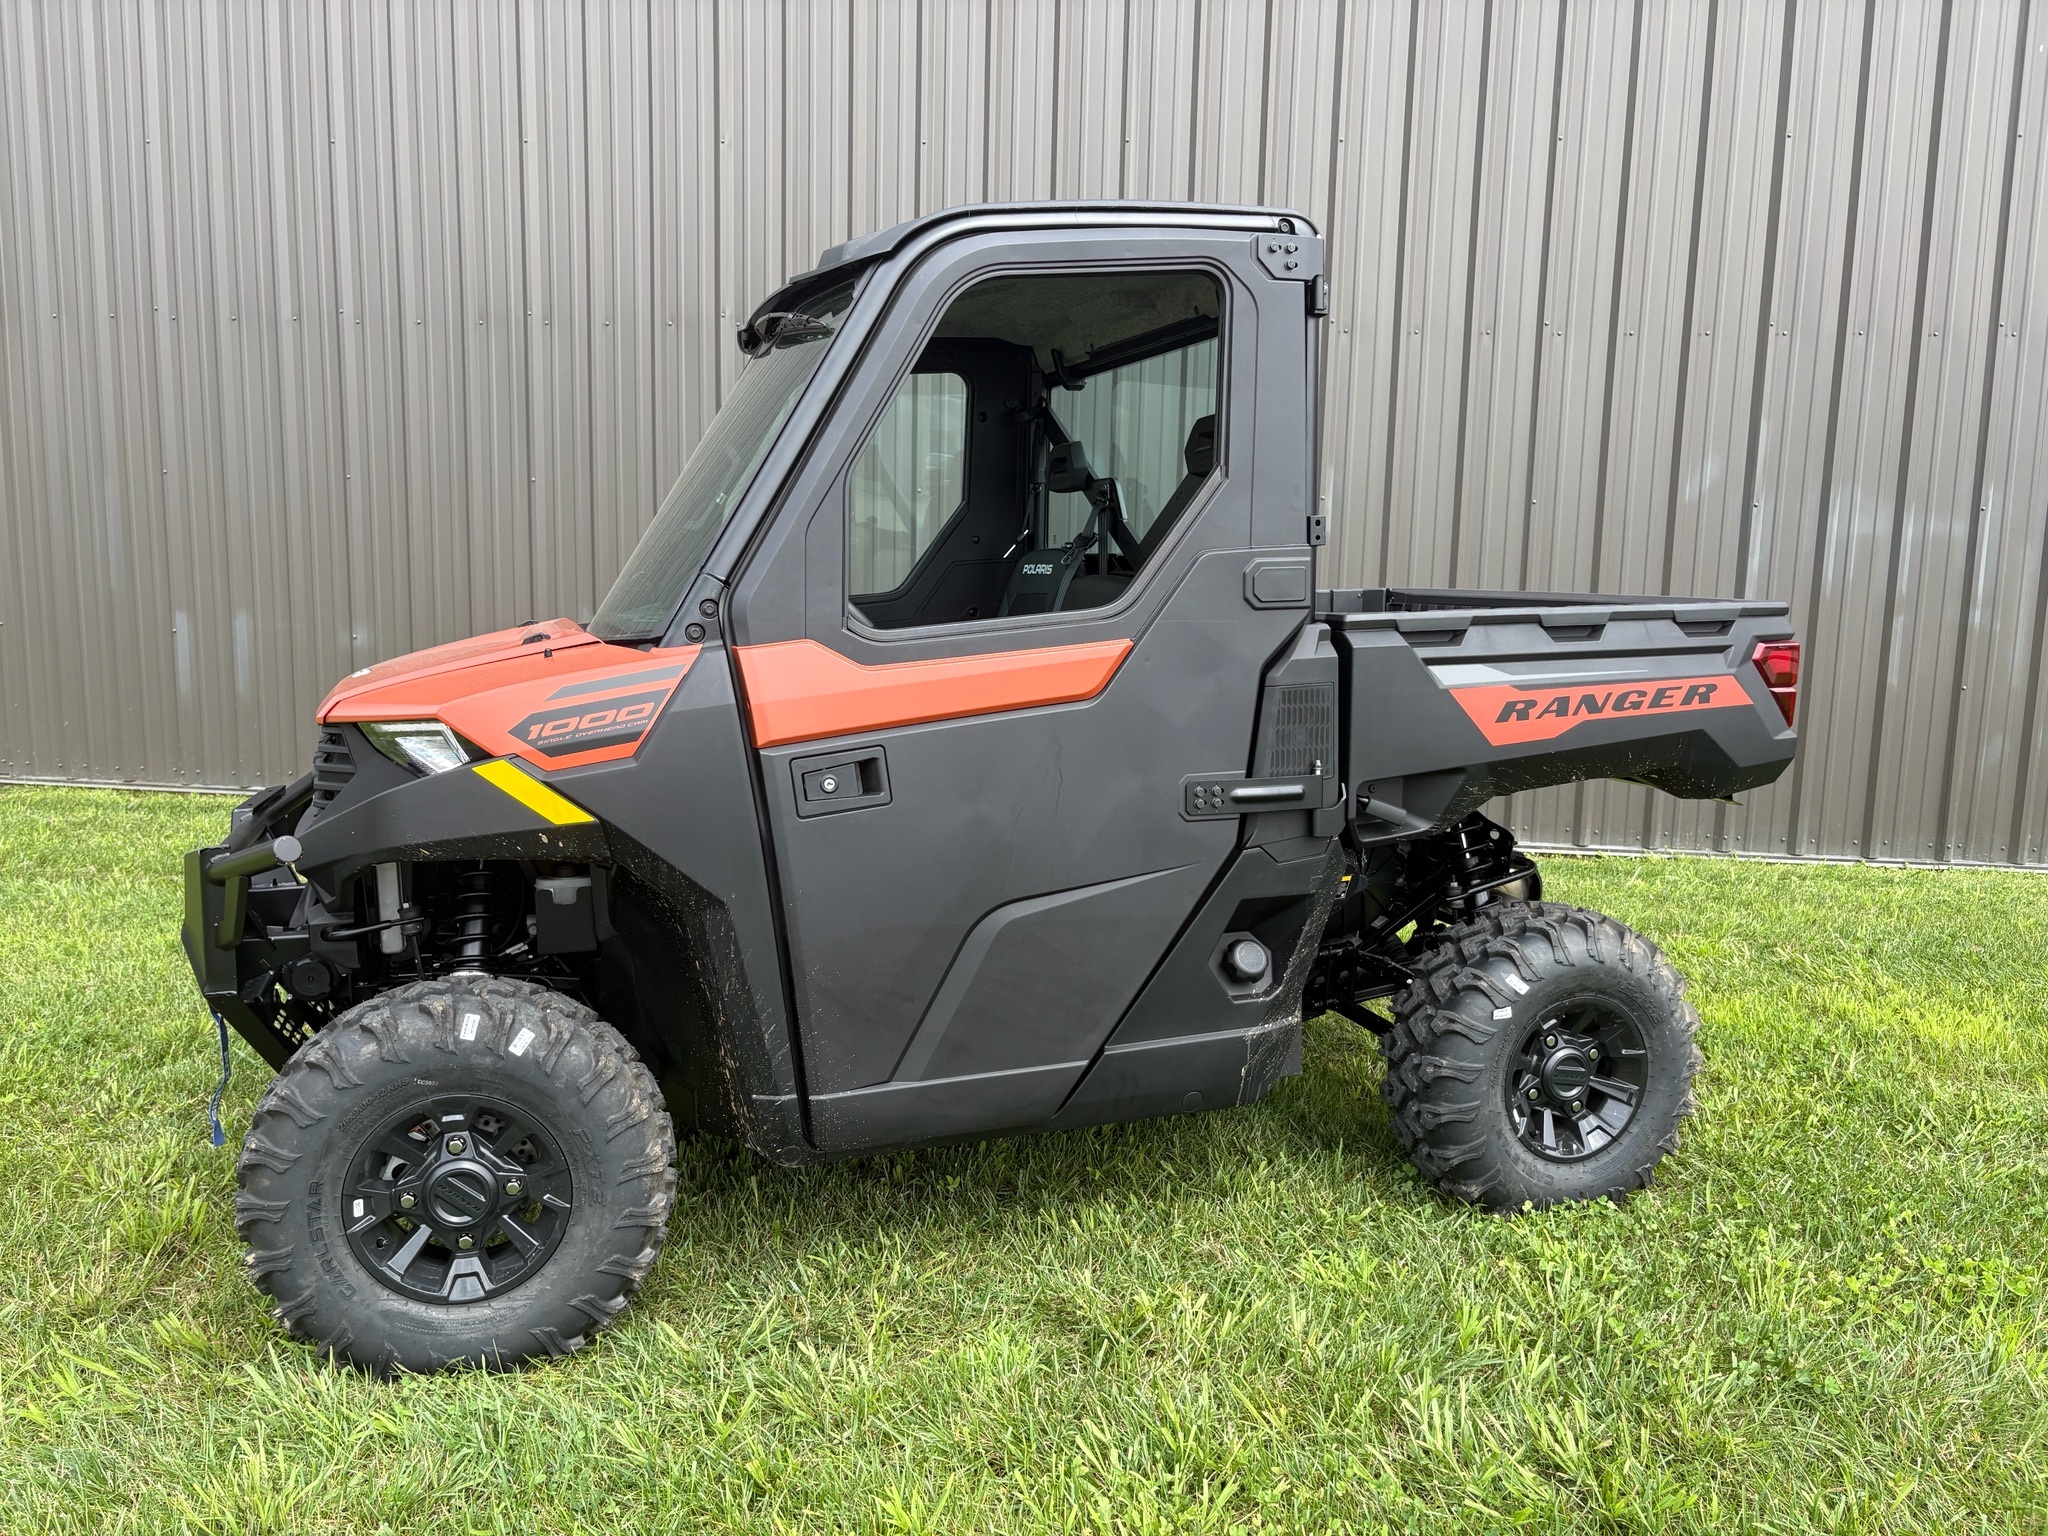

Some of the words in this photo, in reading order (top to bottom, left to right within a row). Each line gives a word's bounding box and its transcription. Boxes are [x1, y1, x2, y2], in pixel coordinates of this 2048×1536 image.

[1022, 564, 1054, 575] POLARIS
[527, 702, 654, 740] 1000
[1494, 683, 1718, 724] RANGER
[536, 734, 573, 746] SINGLE
[575, 724, 627, 738] OVERHEAD
[627, 719, 649, 728] CAM
[306, 1181, 356, 1301] CARLSTAR
